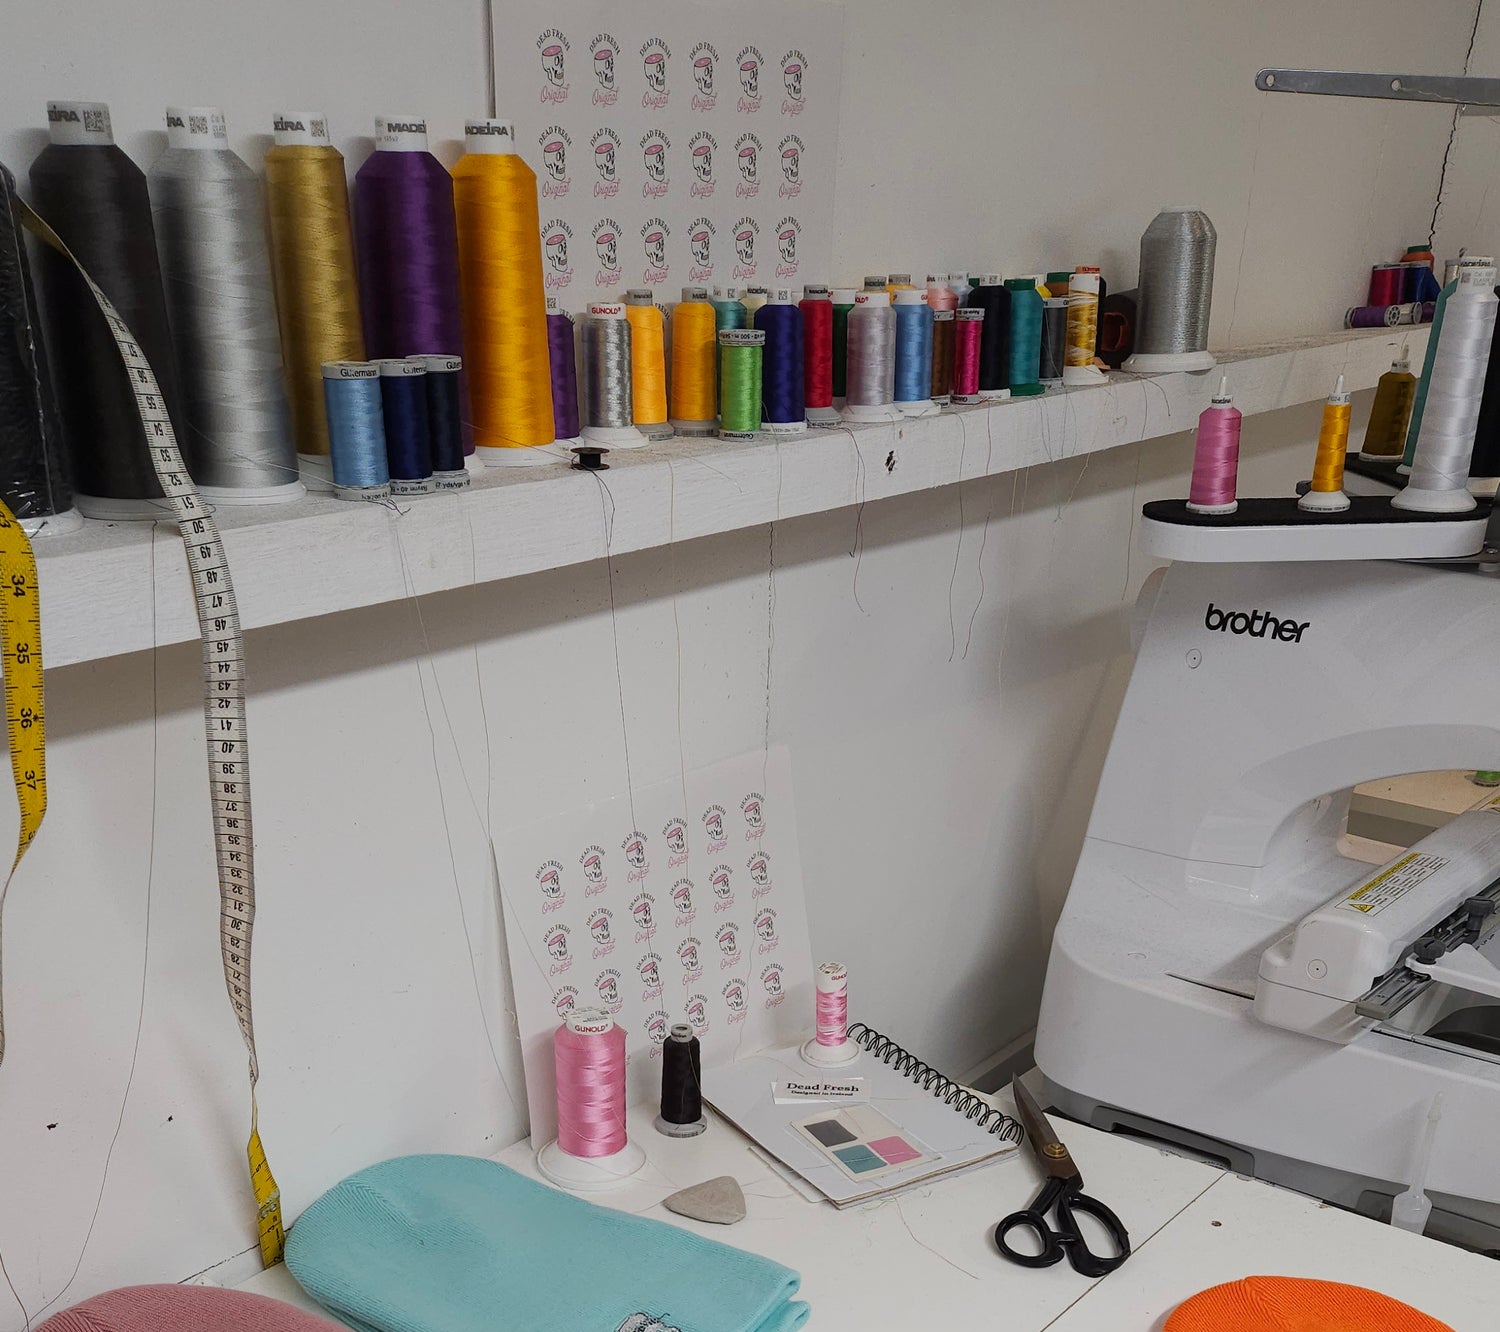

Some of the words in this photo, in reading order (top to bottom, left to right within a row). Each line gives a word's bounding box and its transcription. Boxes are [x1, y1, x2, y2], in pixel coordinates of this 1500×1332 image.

[137, 370, 148, 383] 56
[146, 397, 157, 410] 55
[154, 423, 163, 436] 54
[160, 449, 171, 462] 53
[169, 475, 182, 486] 52
[182, 497, 194, 509] 51
[193, 521, 205, 534] 50
[200, 546, 211, 558] 49
[207, 571, 217, 583] 48
[11, 574, 25, 598] 34
[212, 596, 222, 608] 47
[215, 620, 226, 631] 46
[1205, 603, 1310, 643] brother
[217, 642, 228, 652] 45
[16, 642, 30, 664] 35
[218, 663, 230, 673] 44
[218, 682, 231, 691] 43
[218, 699, 231, 708] 42
[20, 708, 32, 729] 36
[221, 720, 232, 731] 41
[222, 742, 234, 754] 40
[223, 764, 235, 774] 39
[25, 770, 37, 790] 37
[224, 784, 236, 794] 38
[226, 802, 237, 811] 37
[226, 819, 238, 829] 36
[228, 836, 240, 845] 35
[230, 852, 241, 862] 34
[230, 869, 242, 878] 33
[232, 884, 242, 894] 32
[233, 902, 243, 912] 31
[231, 920, 242, 930] 30
